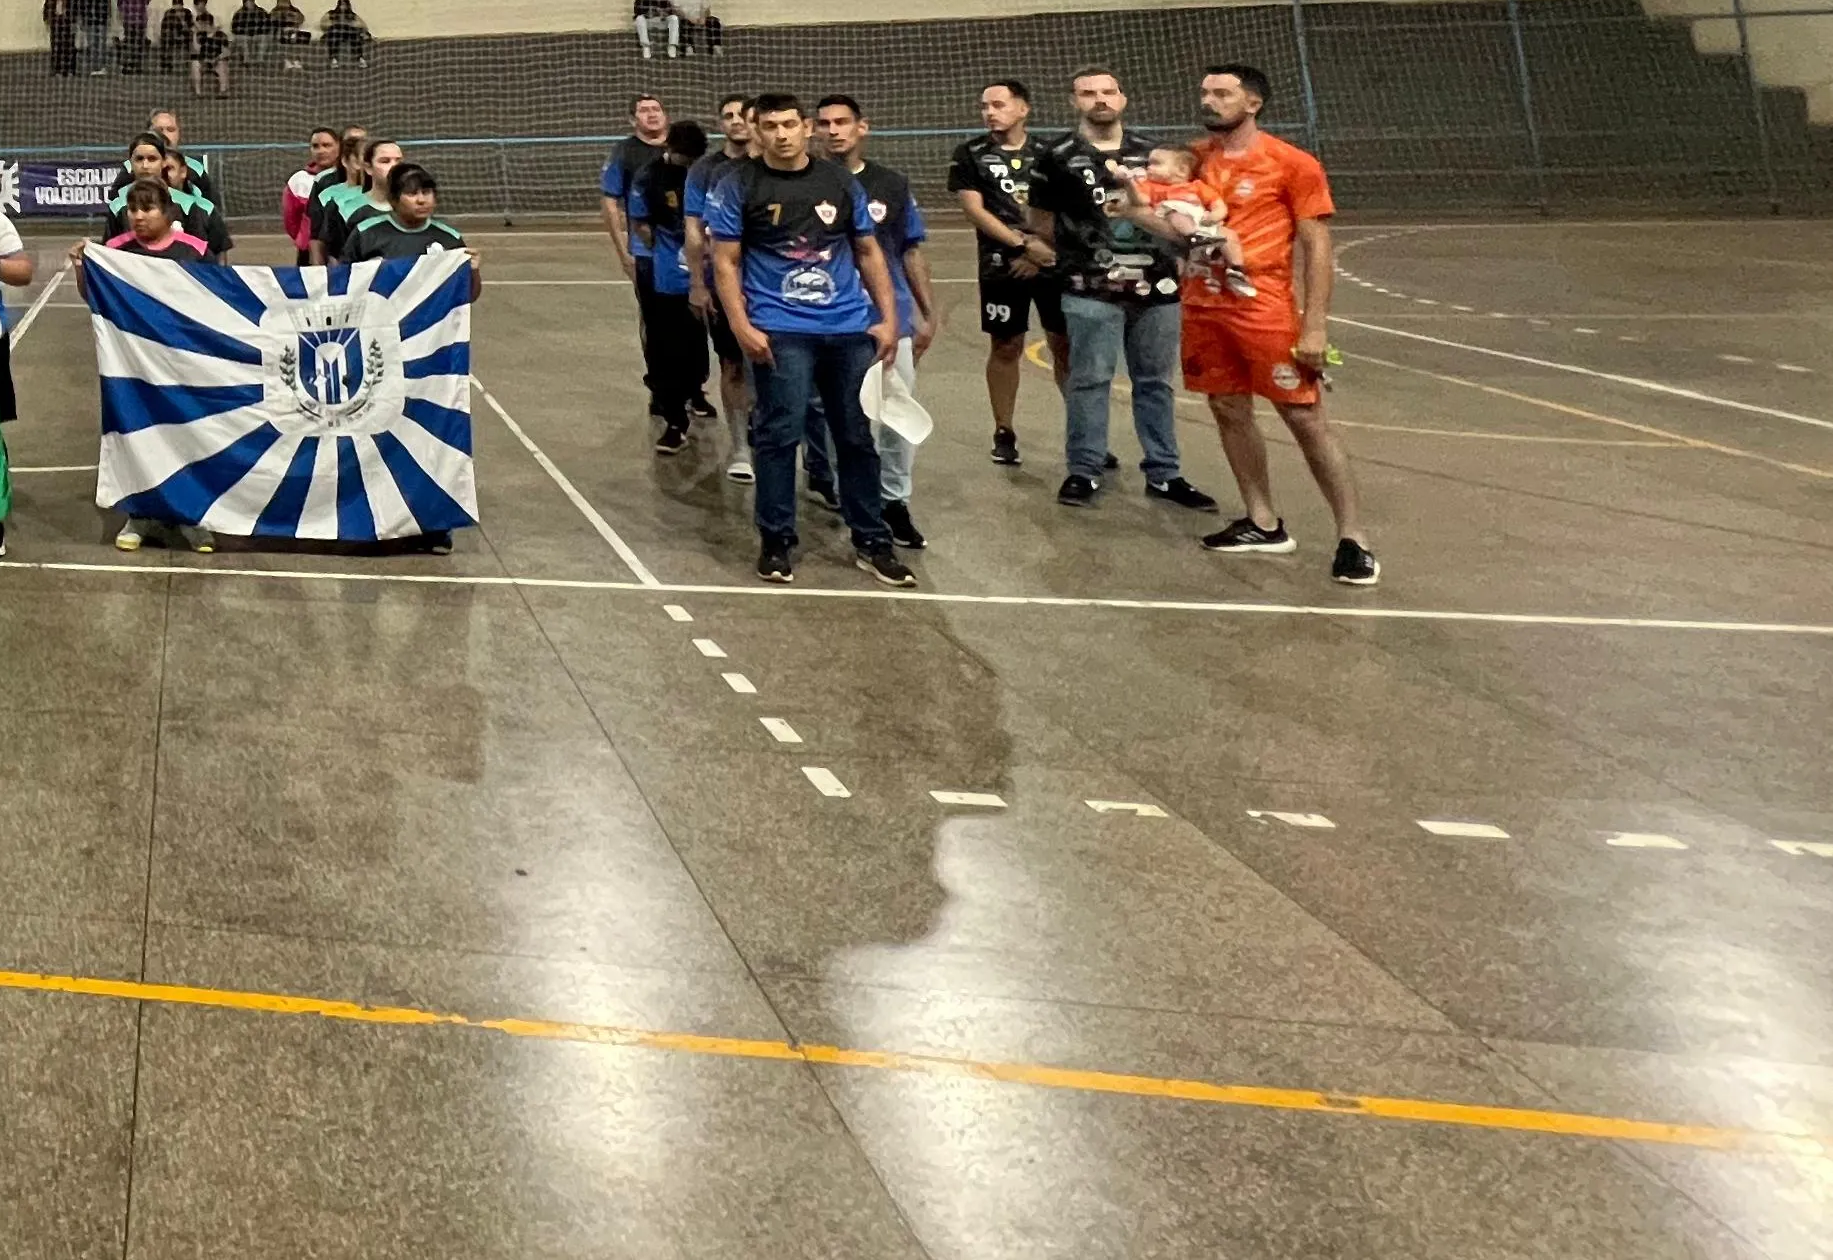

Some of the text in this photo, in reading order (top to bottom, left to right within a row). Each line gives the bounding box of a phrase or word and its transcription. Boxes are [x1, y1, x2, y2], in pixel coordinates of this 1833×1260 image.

[57, 168, 121, 186] ESCOLIN
[34, 186, 103, 205] VOLEIBOL
[768, 203, 782, 226] 7
[986, 302, 1011, 323] 99
